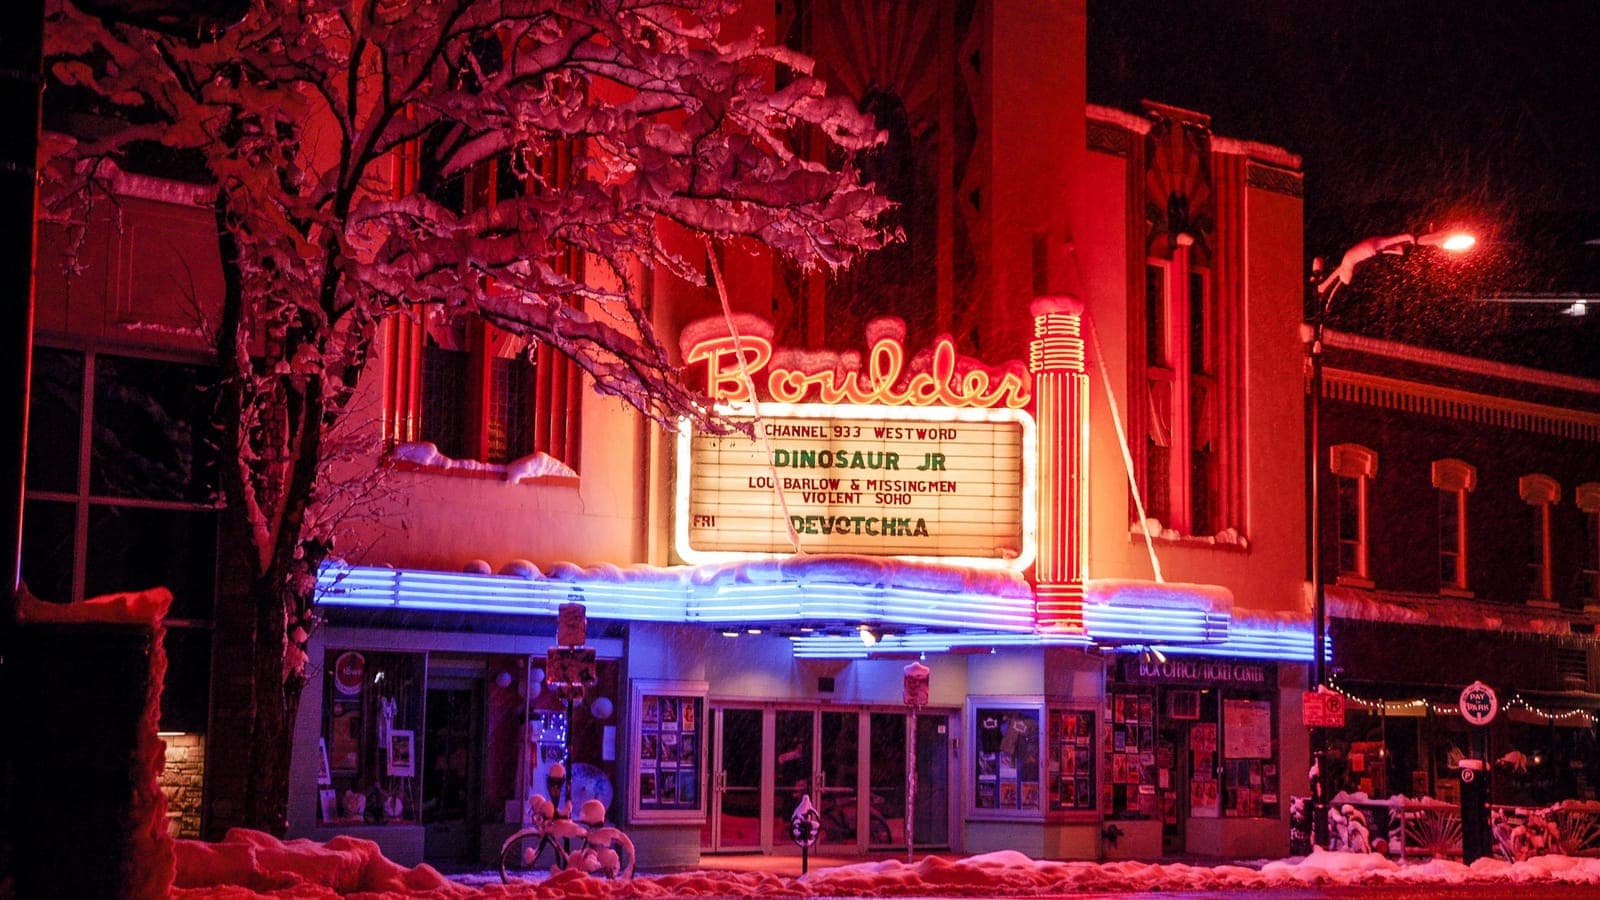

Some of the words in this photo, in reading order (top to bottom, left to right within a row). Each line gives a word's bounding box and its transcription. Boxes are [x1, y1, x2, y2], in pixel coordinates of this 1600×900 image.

[688, 334, 1031, 408] Boulder
[765, 424, 827, 438] CHANNEL
[834, 426, 861, 438] 933
[874, 427, 957, 440] WESTWORD
[774, 449, 899, 470] DINOSAUR
[916, 453, 946, 471] JR
[749, 477, 774, 489] LOU
[784, 478, 840, 490] BARLOW
[850, 479, 860, 491] &
[802, 492, 863, 504] VIOLENT
[875, 493, 911, 505] SOHO
[693, 515, 715, 527] FRI
[790, 515, 928, 537] DEVOTCHKA
[1233, 665, 1265, 682] CENTER
[1470, 693, 1485, 701] PAY
[1467, 702, 1489, 711] PARK
